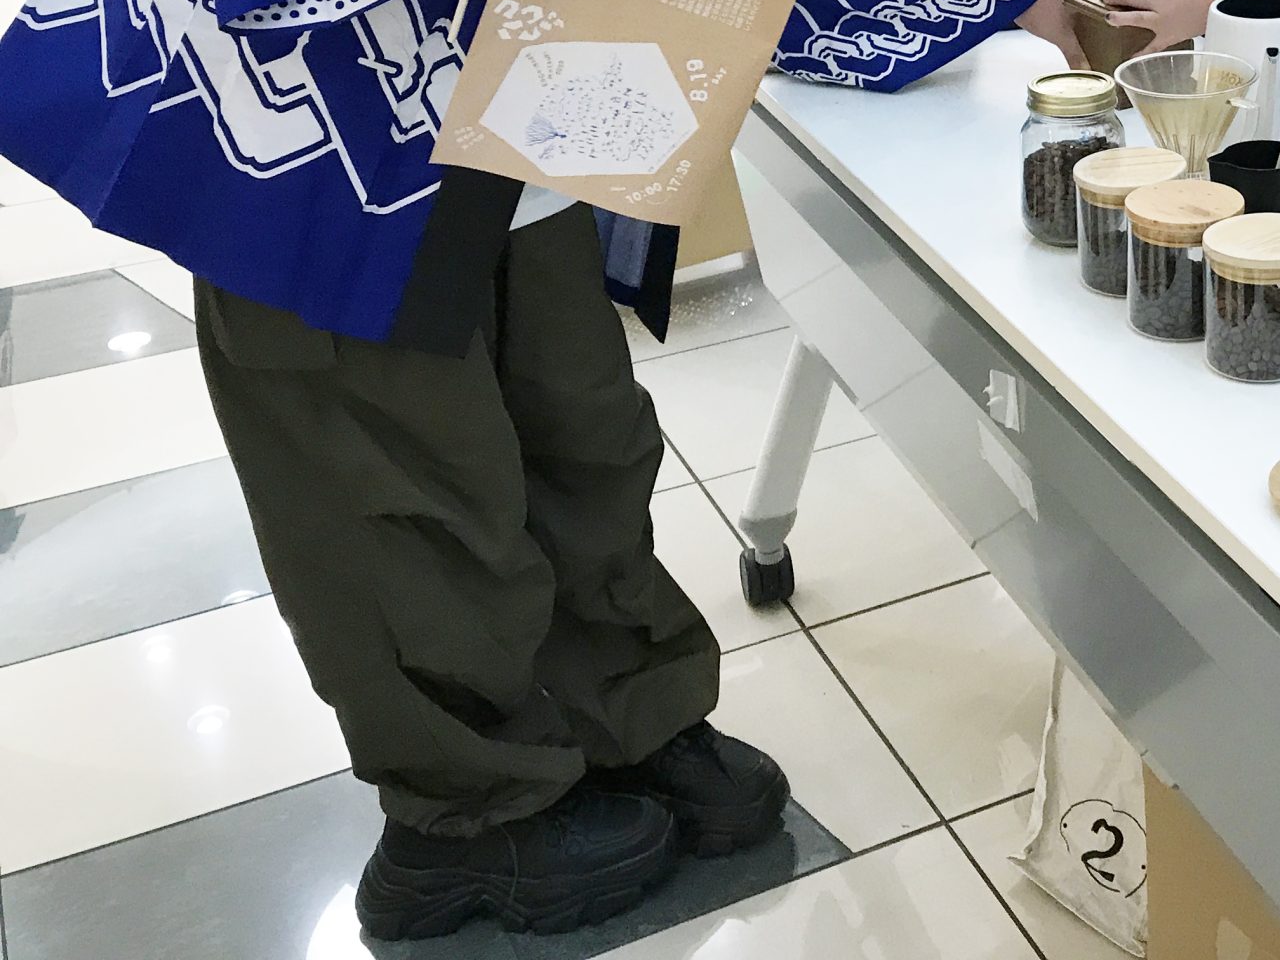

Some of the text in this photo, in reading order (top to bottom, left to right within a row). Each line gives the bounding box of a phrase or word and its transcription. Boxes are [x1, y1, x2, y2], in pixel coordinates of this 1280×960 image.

[686, 58, 708, 102] 8.19
[626, 158, 692, 205] 10:00 17:30
[1080, 818, 1124, 882] 2
